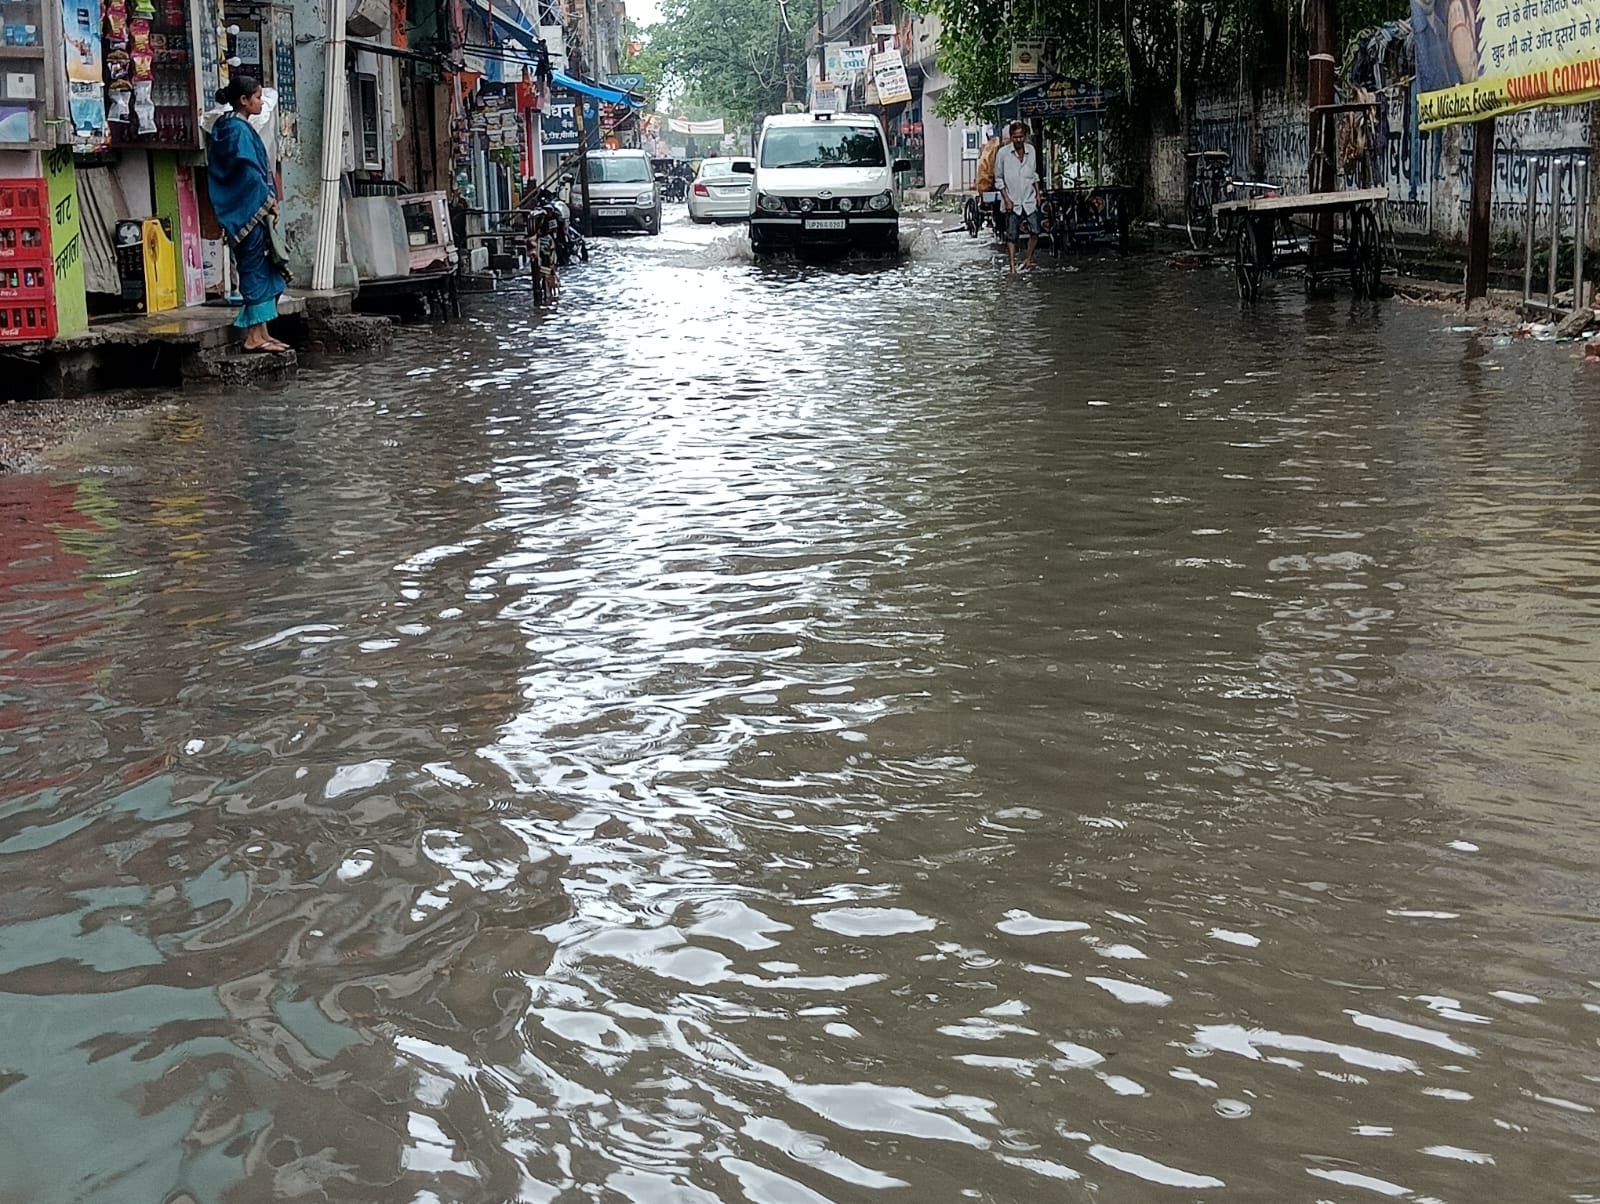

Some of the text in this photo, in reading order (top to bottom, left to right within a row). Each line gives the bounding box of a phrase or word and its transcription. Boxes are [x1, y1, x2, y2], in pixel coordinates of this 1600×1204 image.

[1491, 44, 1505, 68] खुद
[1507, 35, 1518, 57] भी
[1535, 26, 1553, 50] और
[1579, 13, 1592, 38] को
[609, 77, 638, 86] vivo
[1436, 93, 1473, 119] Wishes
[1506, 70, 1551, 106] SUMAN
[1553, 58, 1600, 97] COMPU
[55, 193, 72, 226] चाट
[55, 232, 80, 281] मसाला
